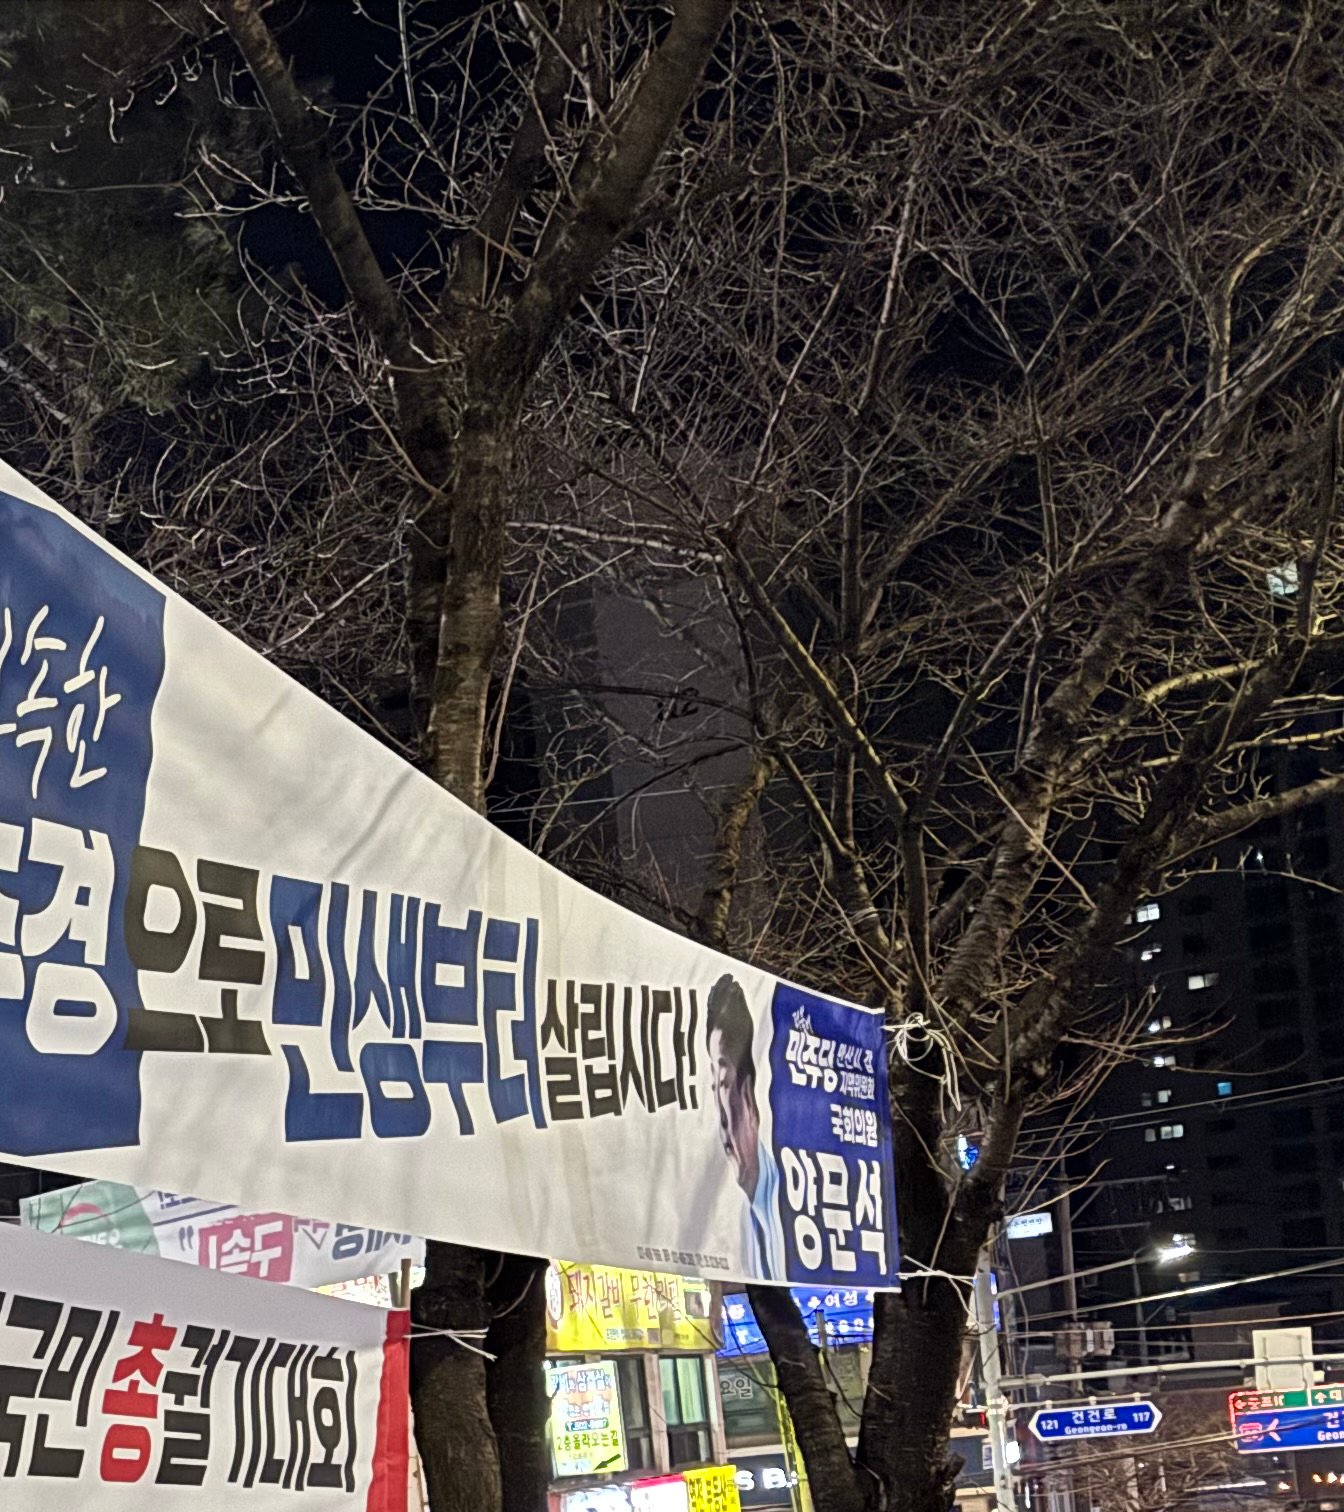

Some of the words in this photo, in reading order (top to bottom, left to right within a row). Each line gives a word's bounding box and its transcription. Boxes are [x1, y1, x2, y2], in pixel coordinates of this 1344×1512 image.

[540, 978, 700, 1123] 살립시다!
[785, 1028, 839, 1093] 민주당
[829, 1102, 879, 1149] 국회의원
[779, 1145, 888, 1277] 양문석
[1040, 1419, 1060, 1431] 121
[1071, 1408, 1118, 1425] 건건로
[1131, 1411, 1151, 1423] 117
[1063, 1423, 1128, 1436] Geongeon-ro
